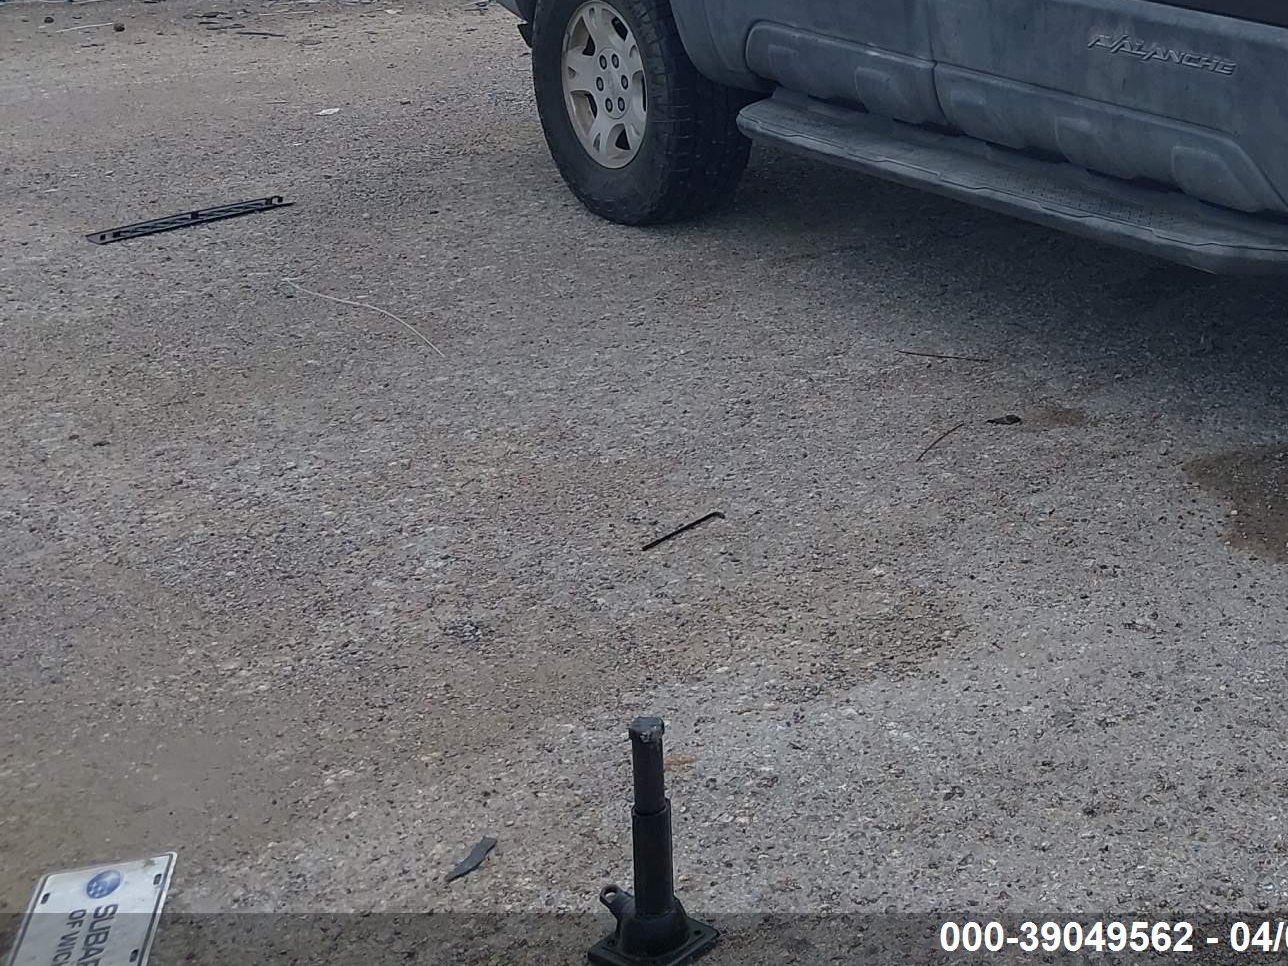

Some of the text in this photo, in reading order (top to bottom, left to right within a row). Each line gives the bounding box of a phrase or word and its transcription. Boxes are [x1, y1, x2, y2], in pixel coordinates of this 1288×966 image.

[1087, 34, 1238, 76] AVALANCHE
[50, 909, 87, 966] OF WIC
